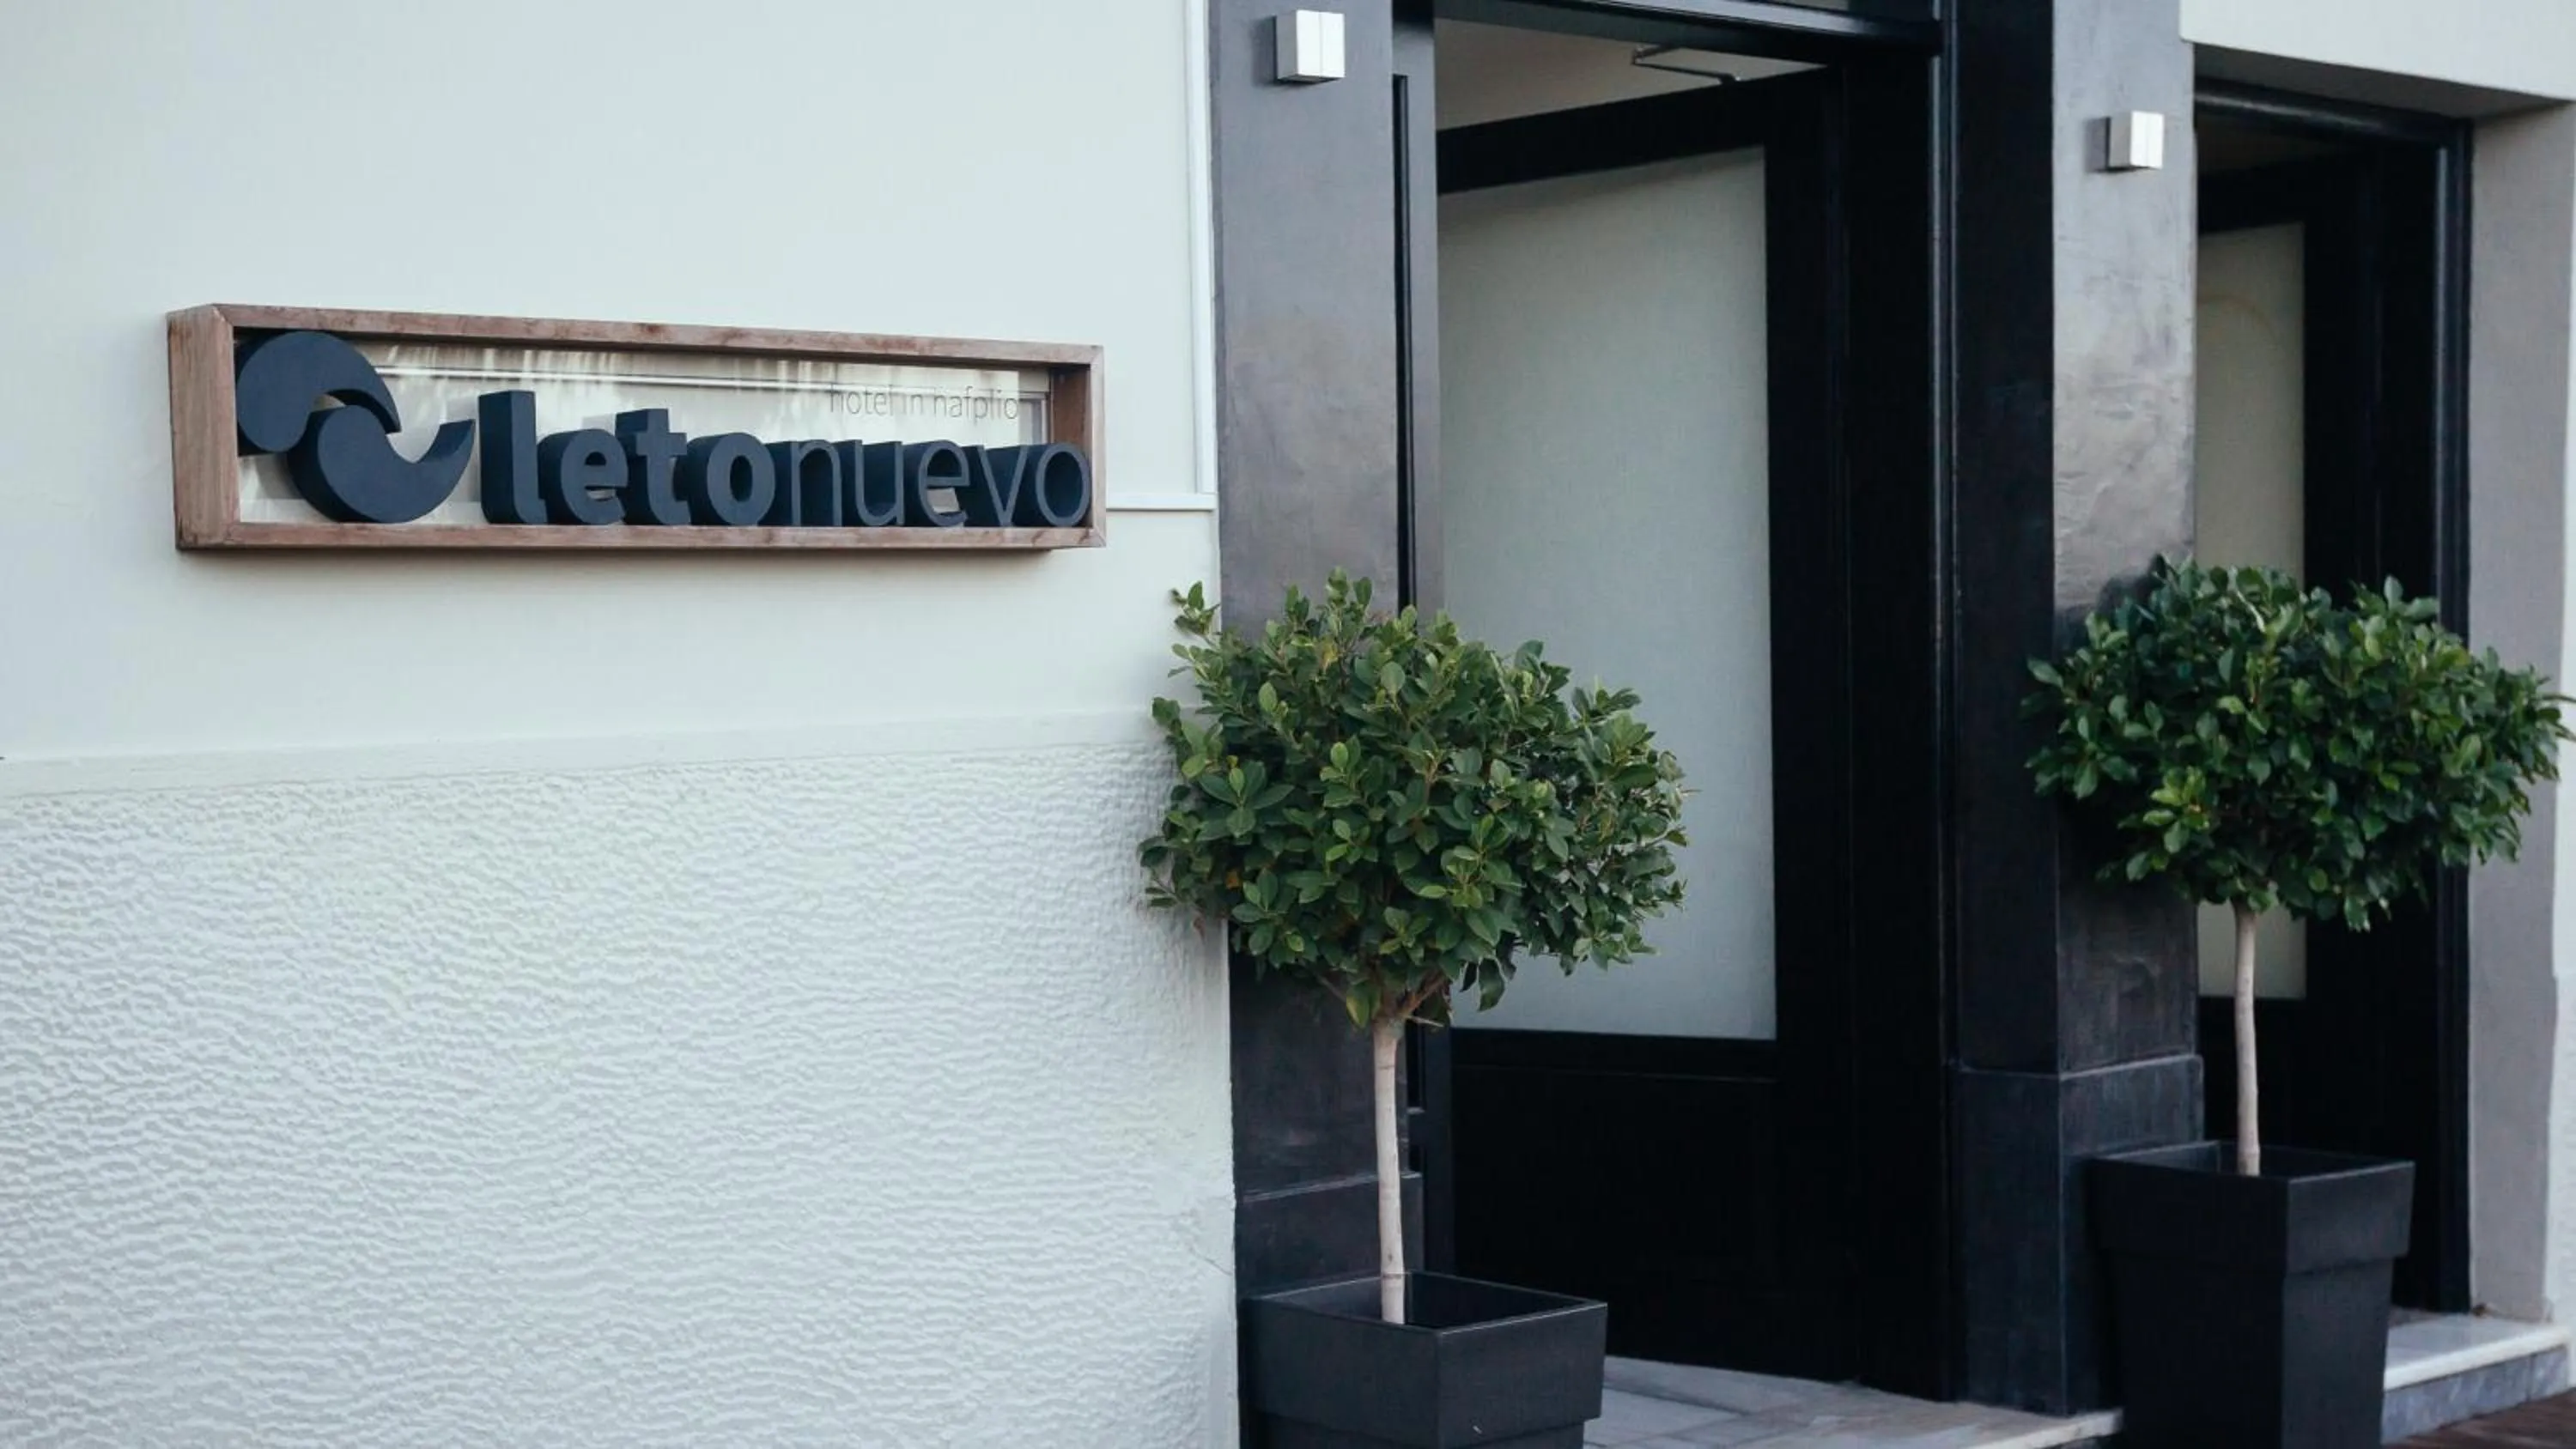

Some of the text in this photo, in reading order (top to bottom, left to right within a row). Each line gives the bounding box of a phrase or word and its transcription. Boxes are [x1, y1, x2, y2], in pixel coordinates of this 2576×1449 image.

[829, 384, 1018, 427] hotel in nafplio
[479, 390, 1091, 526] letonuevo
